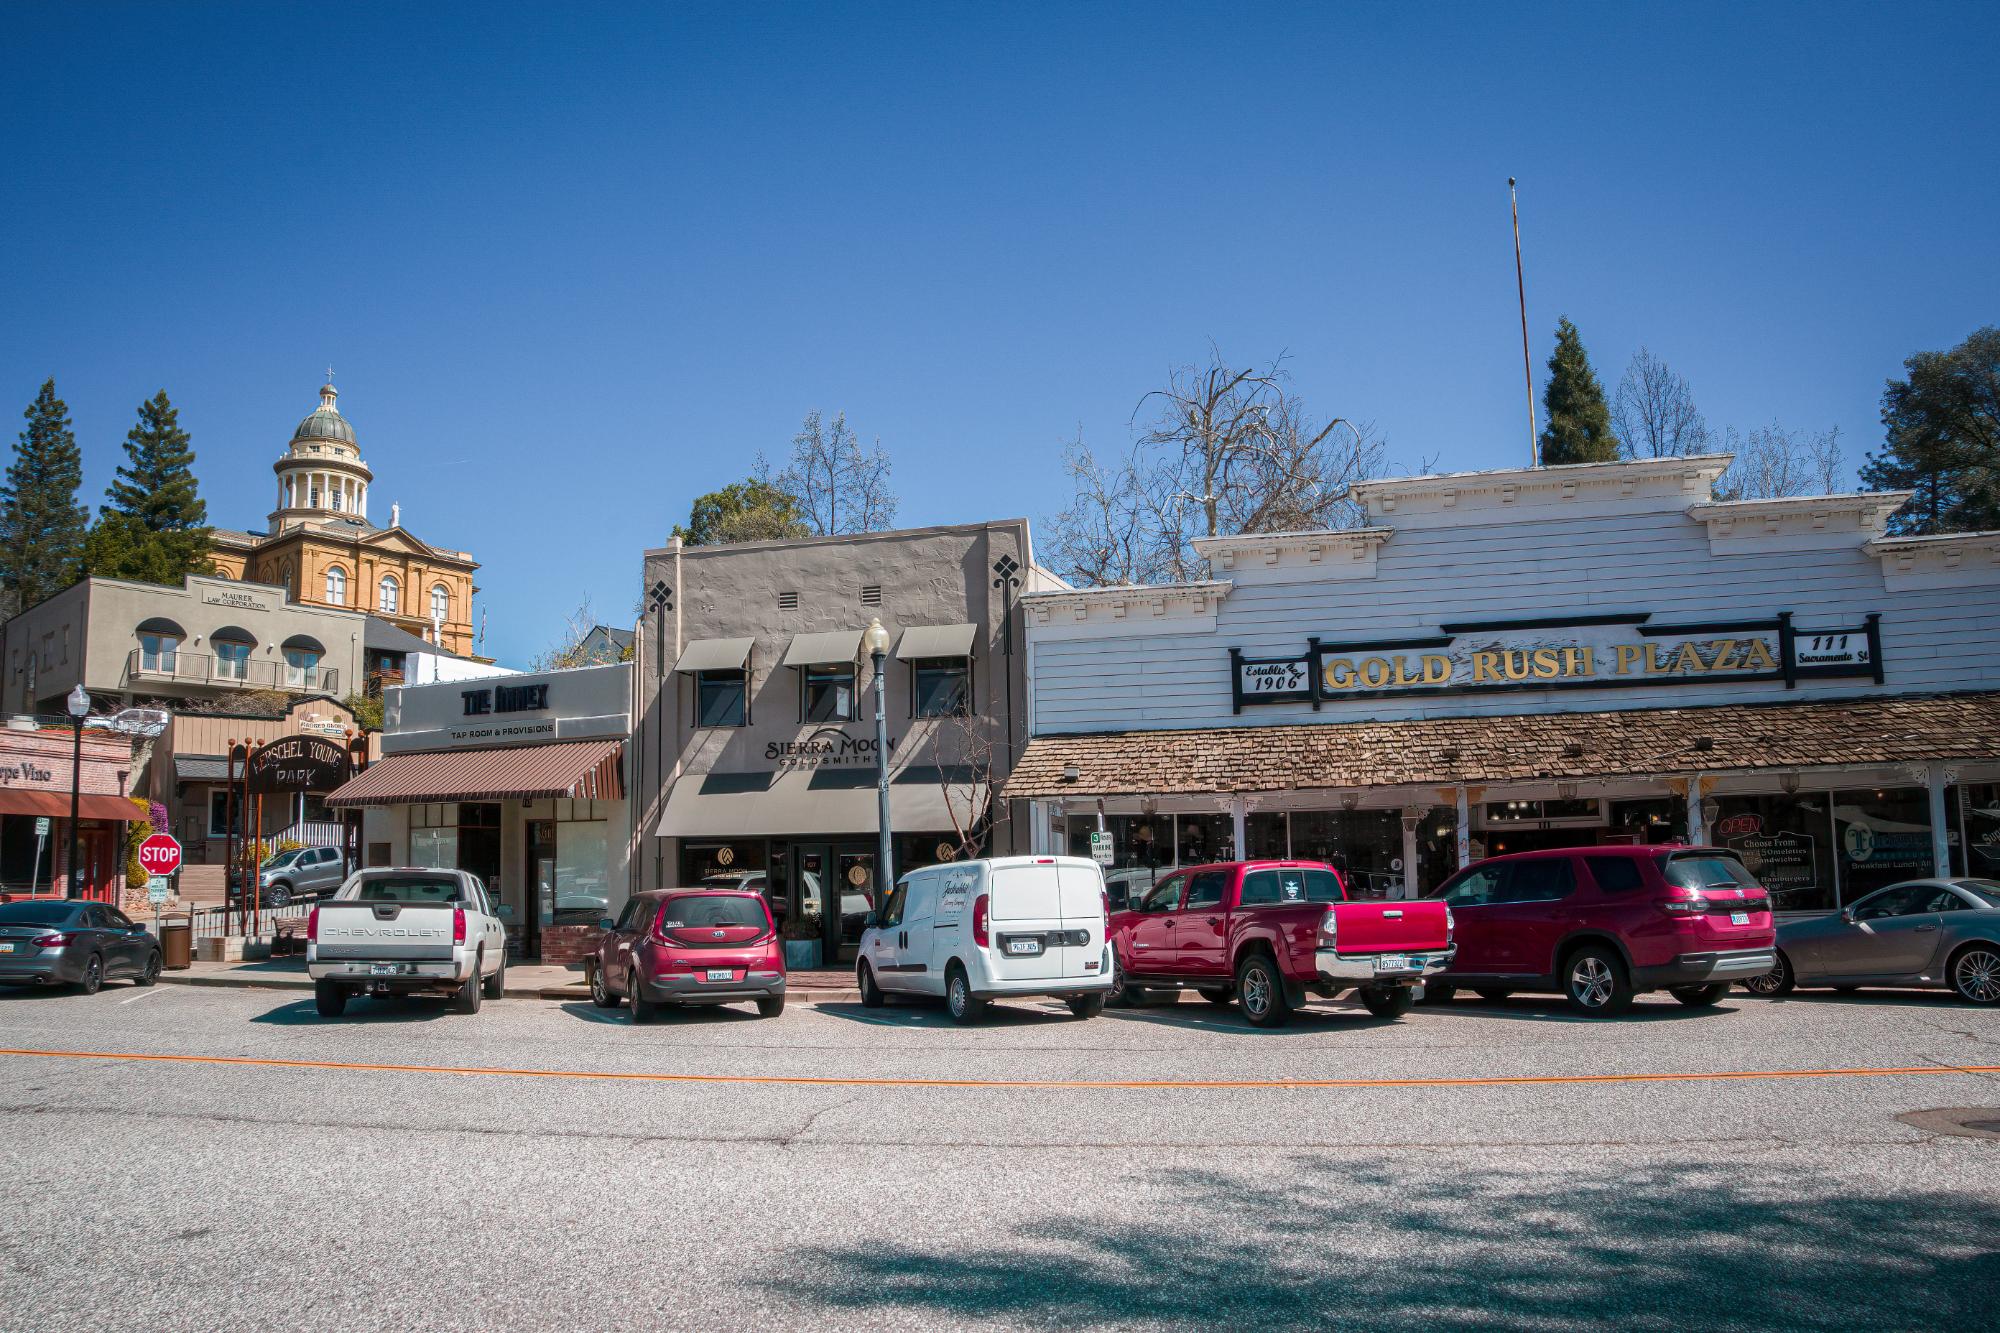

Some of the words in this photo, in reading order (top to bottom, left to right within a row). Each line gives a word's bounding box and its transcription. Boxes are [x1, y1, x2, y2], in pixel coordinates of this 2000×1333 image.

[222, 592, 252, 602] MAURER
[222, 599, 266, 608] CORPORATION
[1812, 634, 1848, 650] 111
[1324, 655, 1451, 688] GOLD
[1472, 646, 1596, 682] RUSH
[1615, 638, 1777, 674] PLAZA
[1799, 652, 1853, 663] Sacramento
[1256, 676, 1297, 690] 1906
[494, 684, 549, 713] ANNEX
[470, 730, 492, 738] ROOM
[502, 724, 554, 736] PROVISIONS
[310, 742, 342, 768] YOUNG
[764, 740, 834, 760] SIERRA
[780, 755, 878, 766] GOLDSMITH
[0, 766, 20, 784] rpe
[21, 762, 51, 781] Vino
[276, 769, 316, 786] PARK
[1720, 818, 1760, 834] OPEN
[1094, 834, 1099, 842] 3
[1744, 840, 1772, 848] Choose
[142, 847, 178, 862] STOP
[324, 928, 446, 937] CHEVROLET
